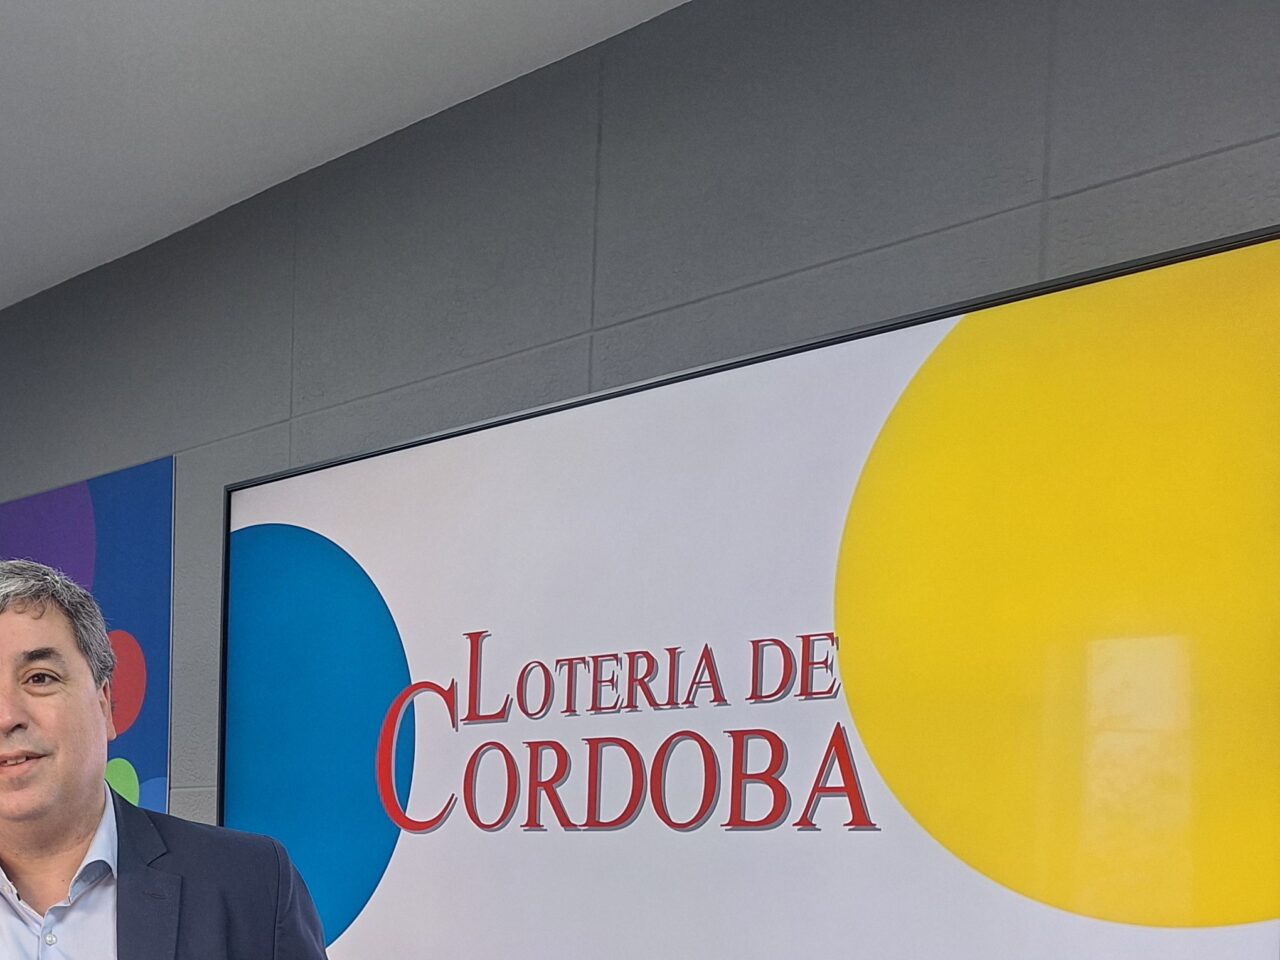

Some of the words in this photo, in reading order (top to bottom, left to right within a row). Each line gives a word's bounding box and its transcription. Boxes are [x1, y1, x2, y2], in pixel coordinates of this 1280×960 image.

[460, 630, 731, 725] LOTERIA
[745, 632, 842, 704] DE
[376, 678, 881, 834] CORDOBA
